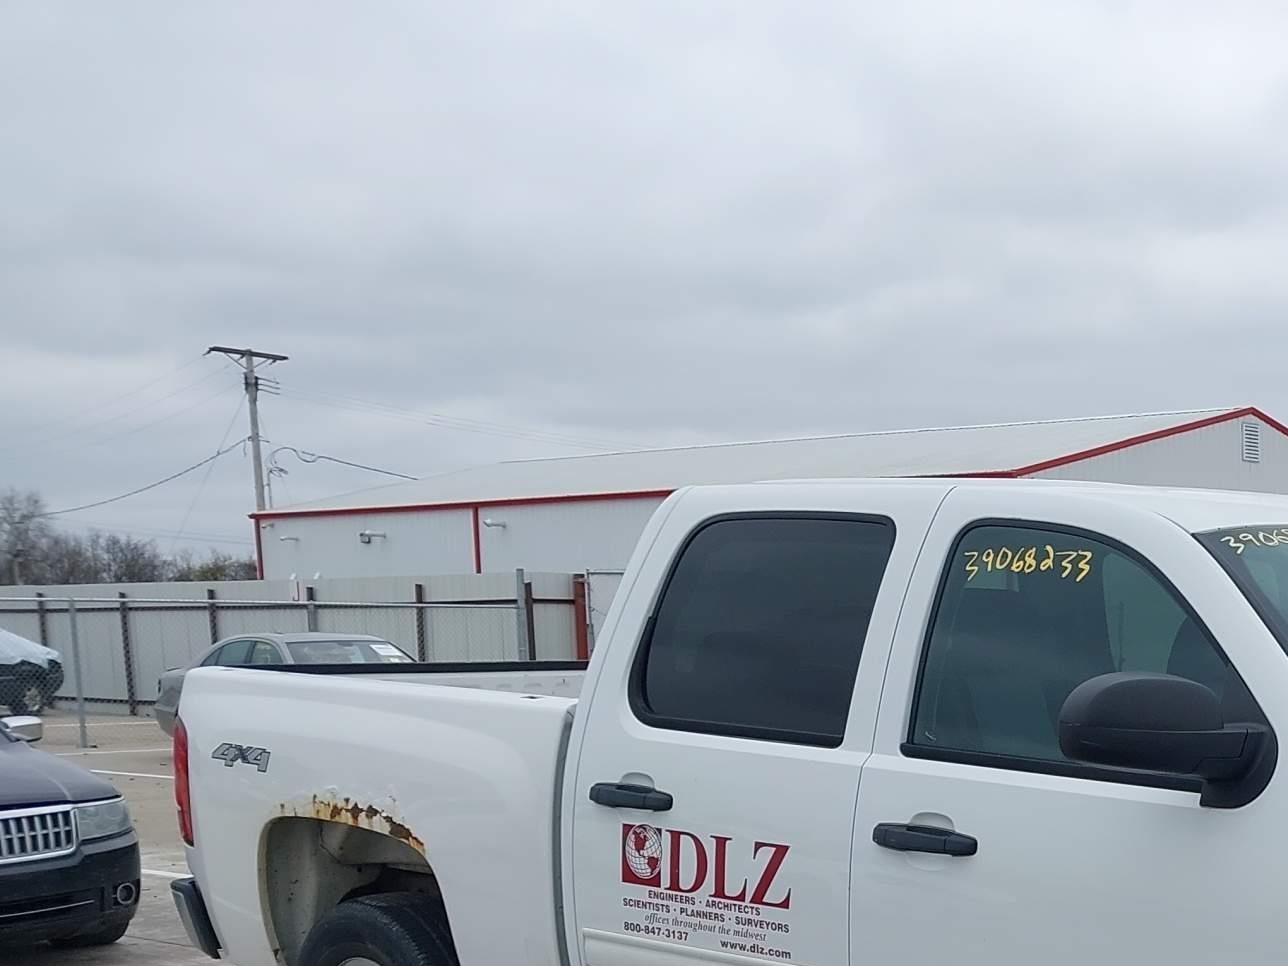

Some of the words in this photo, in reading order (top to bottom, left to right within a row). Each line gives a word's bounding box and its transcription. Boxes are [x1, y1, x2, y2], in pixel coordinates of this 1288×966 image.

[963, 545, 1093, 583] 39068233
[664, 829, 791, 909] DLZ
[623, 898, 670, 913] SCIENTISTS
[680, 907, 725, 923] PLANNERS
[735, 916, 789, 933] SURVEYORS
[648, 890, 696, 906] ENGINEERS
[705, 900, 761, 916] ARCHITECTS
[624, 922, 689, 941] 800-847-3137
[645, 913, 670, 925] offices
[671, 917, 716, 932] throughout
[718, 923, 731, 935] the
[733, 927, 767, 941] midwest
[720, 940, 791, 959] www.dlz.com
